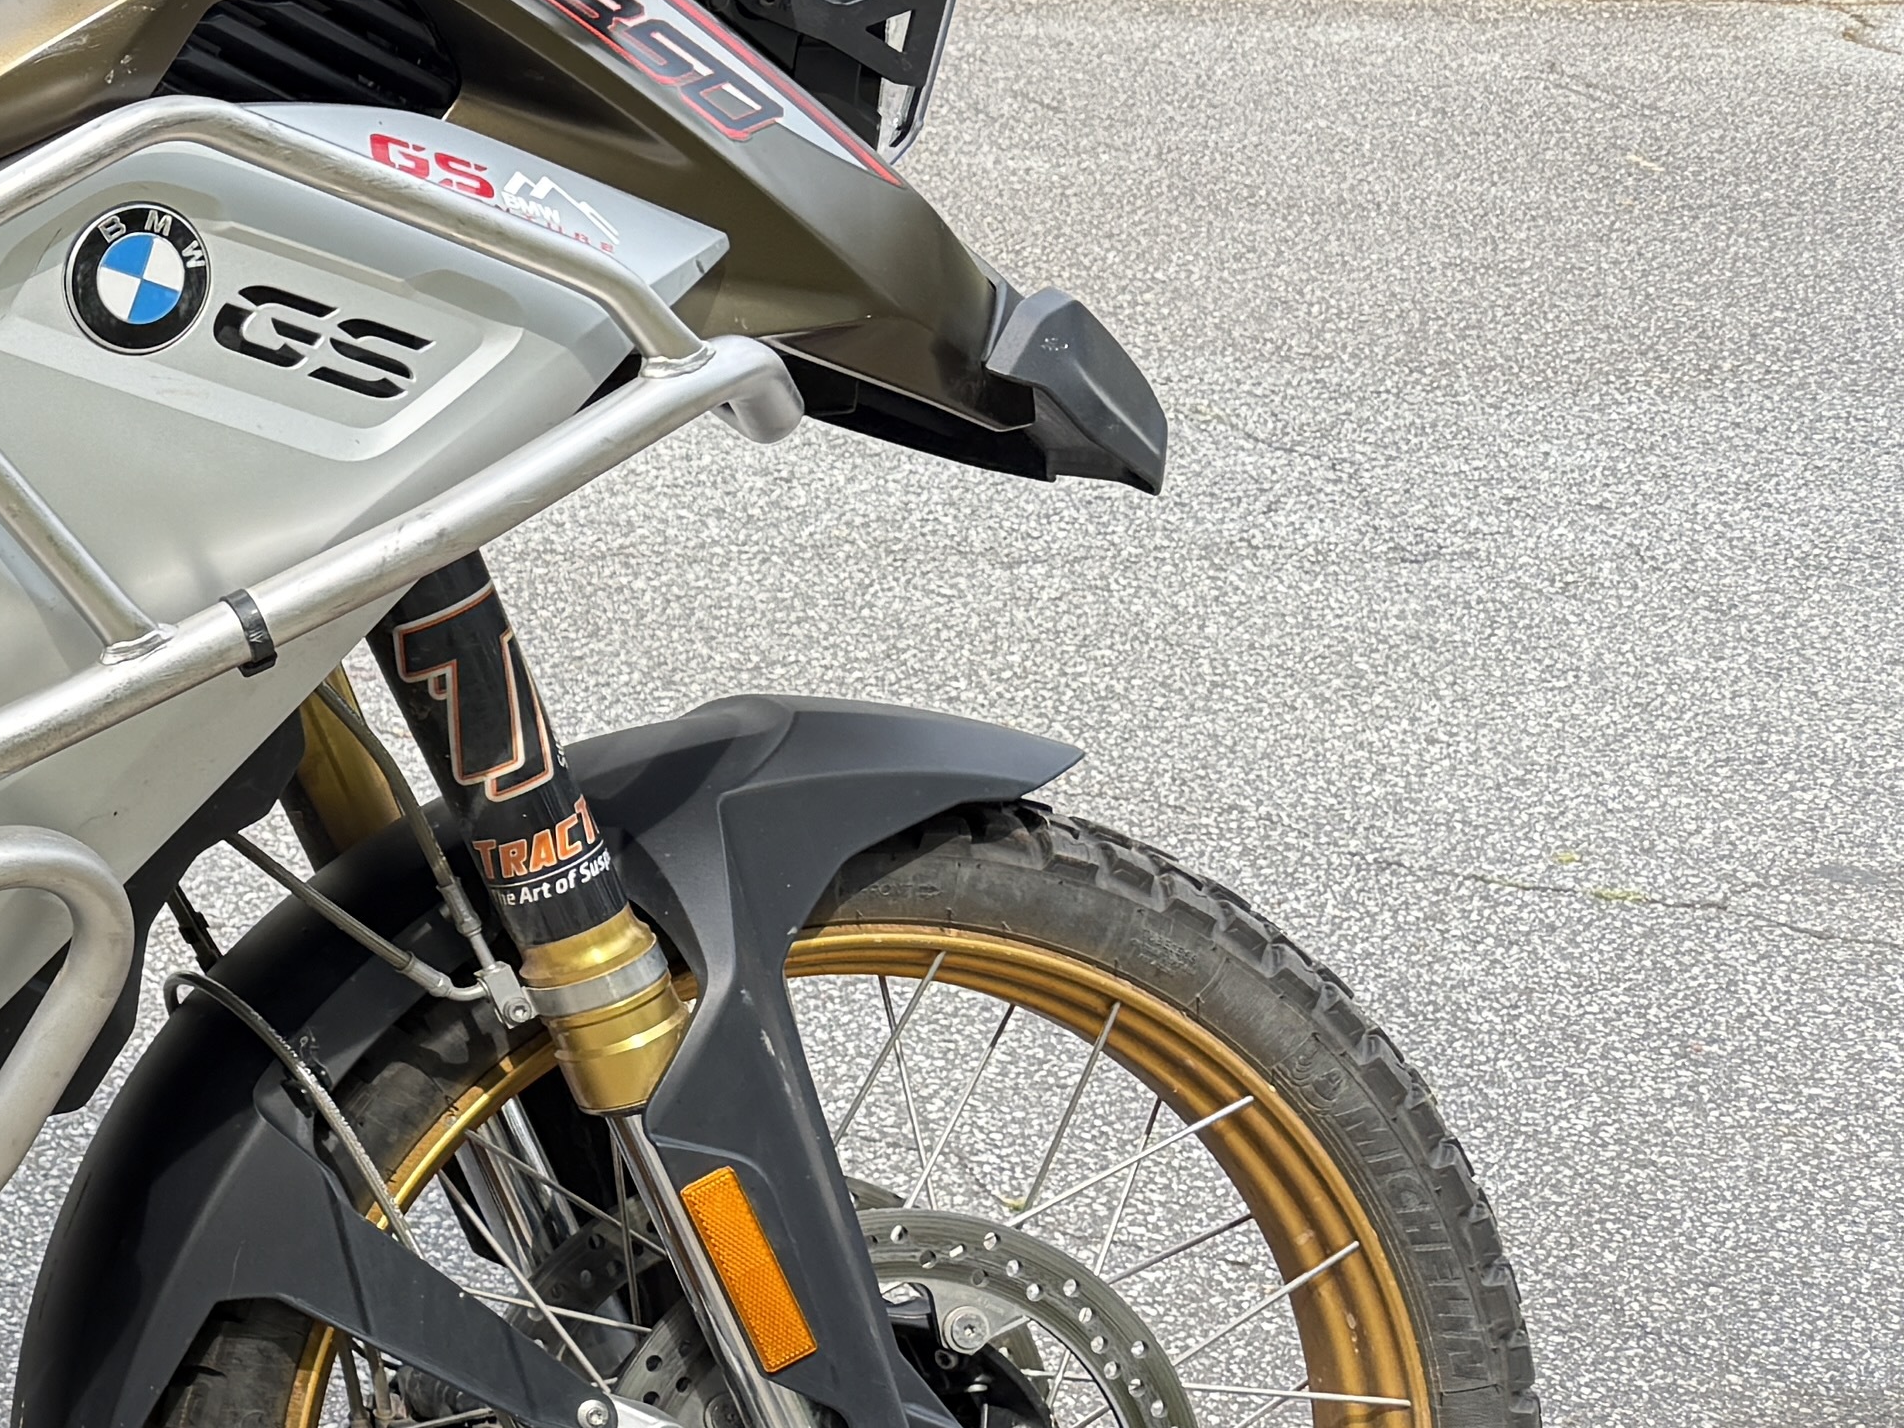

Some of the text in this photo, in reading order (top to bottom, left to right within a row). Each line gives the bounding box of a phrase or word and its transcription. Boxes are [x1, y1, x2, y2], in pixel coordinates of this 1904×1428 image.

[369, 133, 496, 200] GS
[501, 190, 562, 225] BMW
[96, 209, 207, 270] BMW
[214, 284, 434, 400] GS
[519, 881, 553, 905] Art
[555, 869, 577, 895] of
